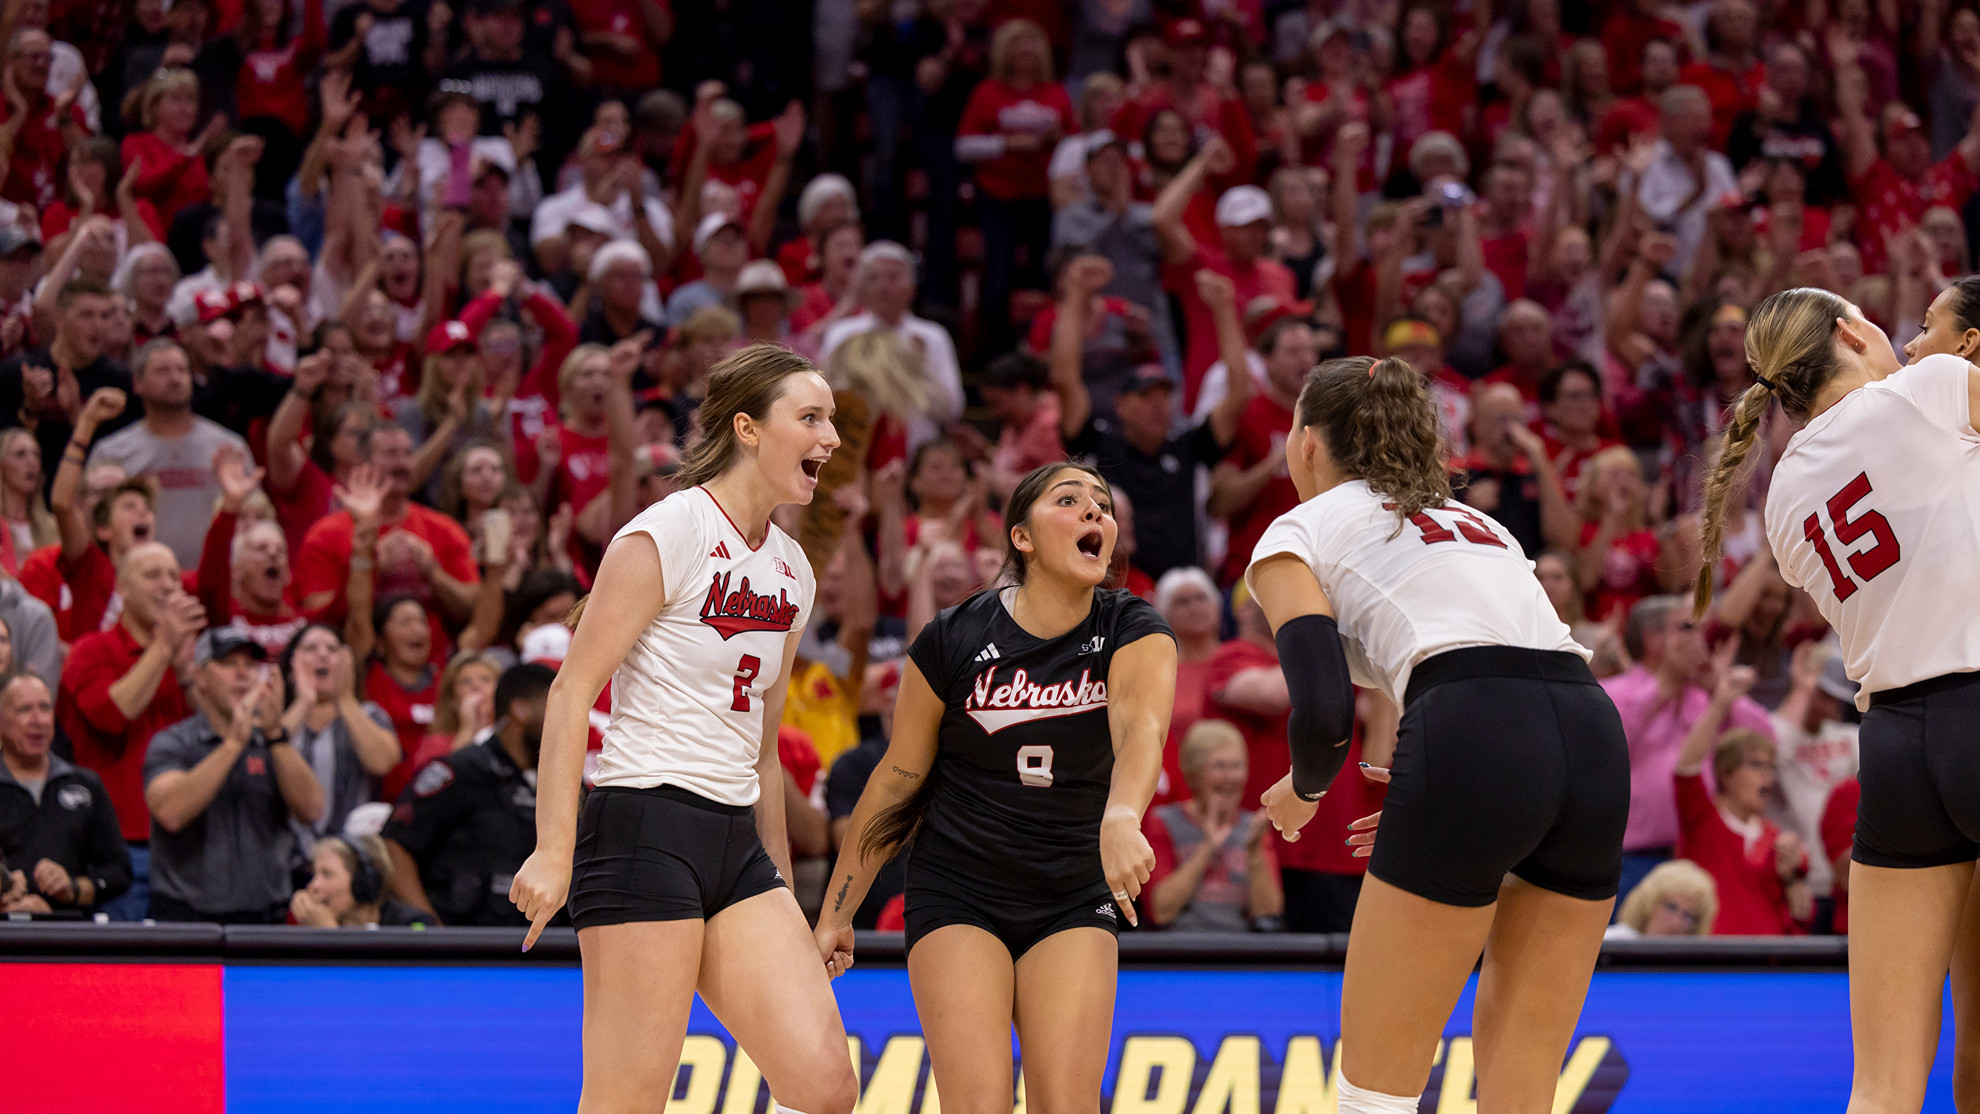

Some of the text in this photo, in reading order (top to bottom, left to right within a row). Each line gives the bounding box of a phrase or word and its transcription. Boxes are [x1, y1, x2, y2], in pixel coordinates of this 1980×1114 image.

[1382, 502, 1508, 550] 13
[1804, 470, 1901, 604] 15
[699, 571, 800, 626] Nebraska
[730, 653, 761, 713] 2
[965, 665, 1108, 710] Nebraska
[1016, 744, 1055, 788] 8
